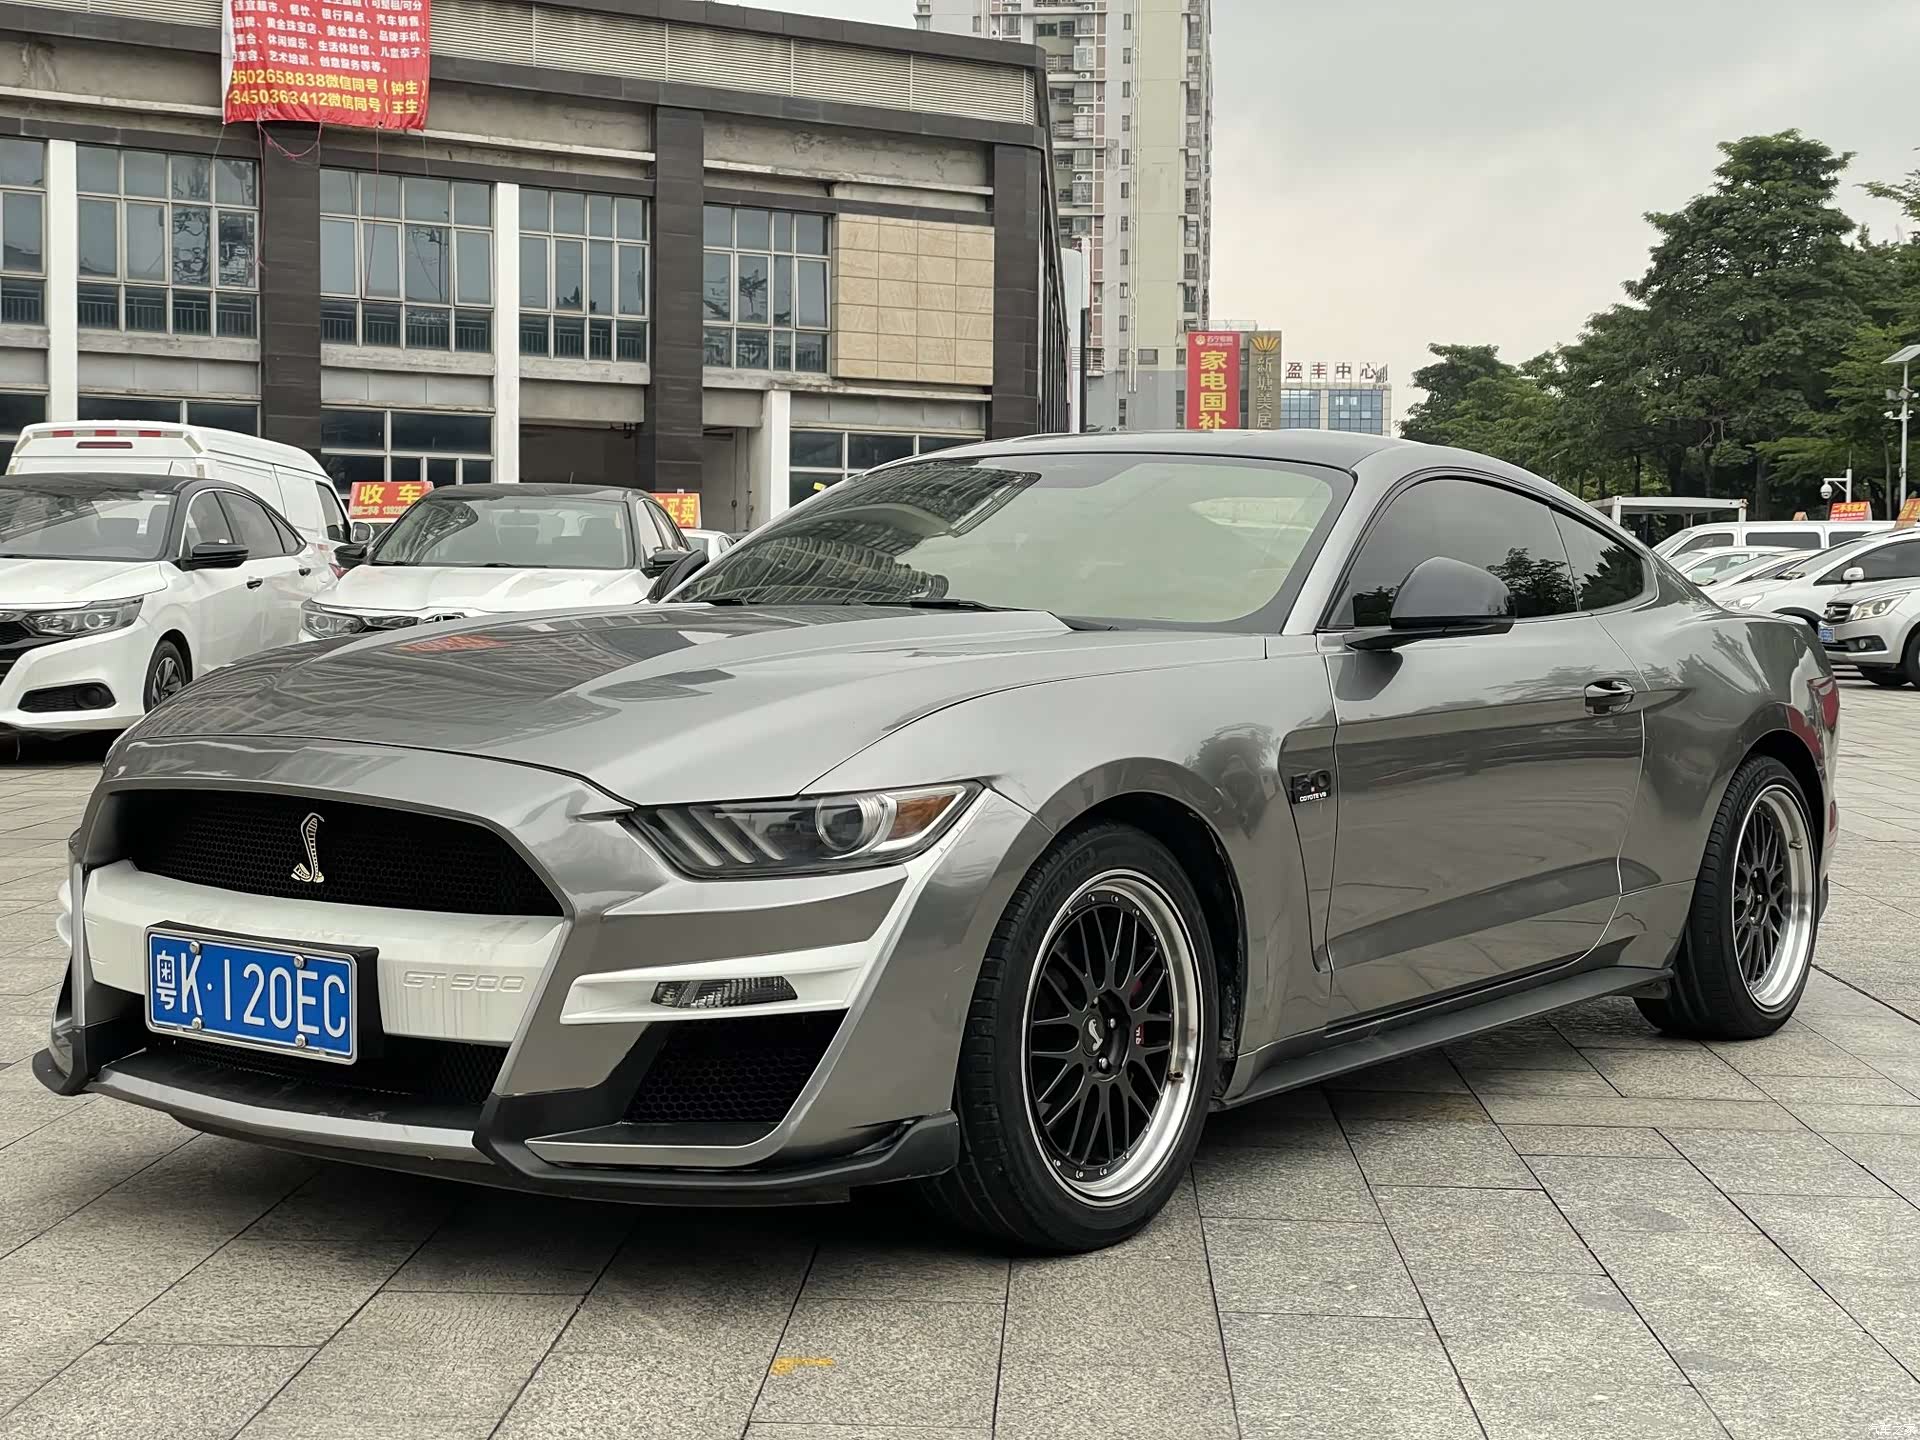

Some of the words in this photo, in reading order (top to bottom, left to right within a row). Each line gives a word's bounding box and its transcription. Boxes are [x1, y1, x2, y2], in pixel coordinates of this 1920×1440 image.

[1285, 362, 1377, 379] 盈丰中心
[1199, 351, 1228, 429] 家电国补
[359, 484, 423, 504] 收车
